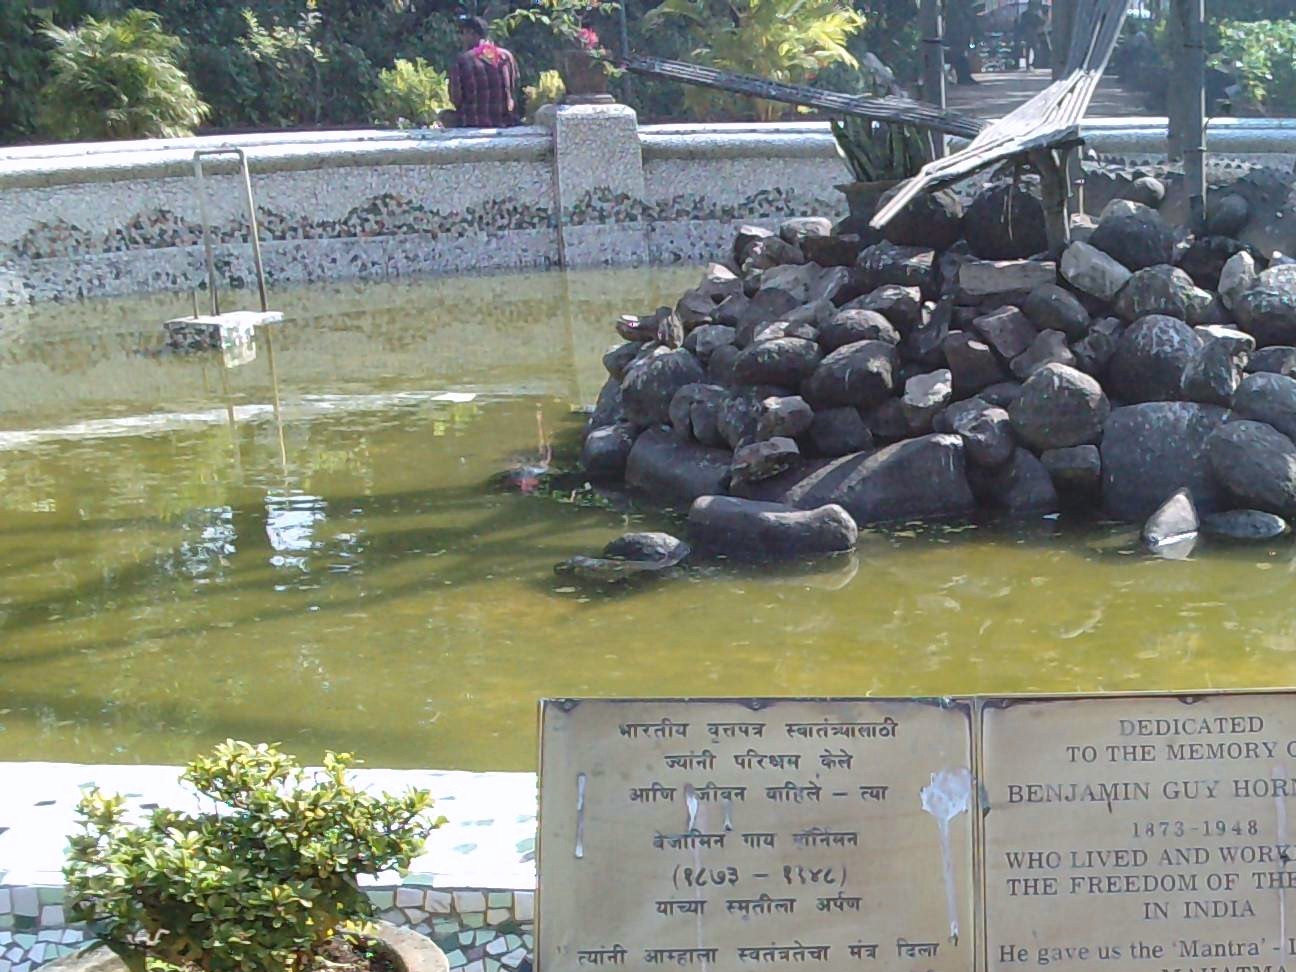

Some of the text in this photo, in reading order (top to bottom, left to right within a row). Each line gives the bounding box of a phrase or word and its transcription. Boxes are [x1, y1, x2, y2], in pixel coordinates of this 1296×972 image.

[1119, 716, 1264, 737] DEDICATED
[819, 749, 854, 770] केले
[1066, 745, 1097, 763] TO
[1105, 744, 1156, 762] THE
[1166, 741, 1278, 761] MEMORY
[630, 782, 677, 802] आणि
[695, 782, 747, 802] जीवन
[859, 786, 889, 801] त्या
[1007, 782, 1151, 804] BENJAMIN
[1163, 780, 1220, 800] GUY
[1131, 820, 1259, 838] 1873-1948
[741, 832, 776, 848] गाय
[1005, 851, 1062, 870] WHO
[1070, 849, 1149, 869] LIVED
[1159, 847, 1210, 866] AND
[1006, 876, 1058, 896] THE
[1069, 873, 1198, 894] FREEDOM
[1207, 872, 1240, 891] OF
[816, 891, 862, 912] अर्पण
[1143, 900, 1256, 920] IN INDIA
[644, 947, 718, 966] आम्हाला
[848, 942, 878, 960] मंत्र
[999, 944, 1029, 964] He
[1036, 945, 1090, 966] gave
[1098, 944, 1122, 960] us
[1130, 940, 1163, 960] the
